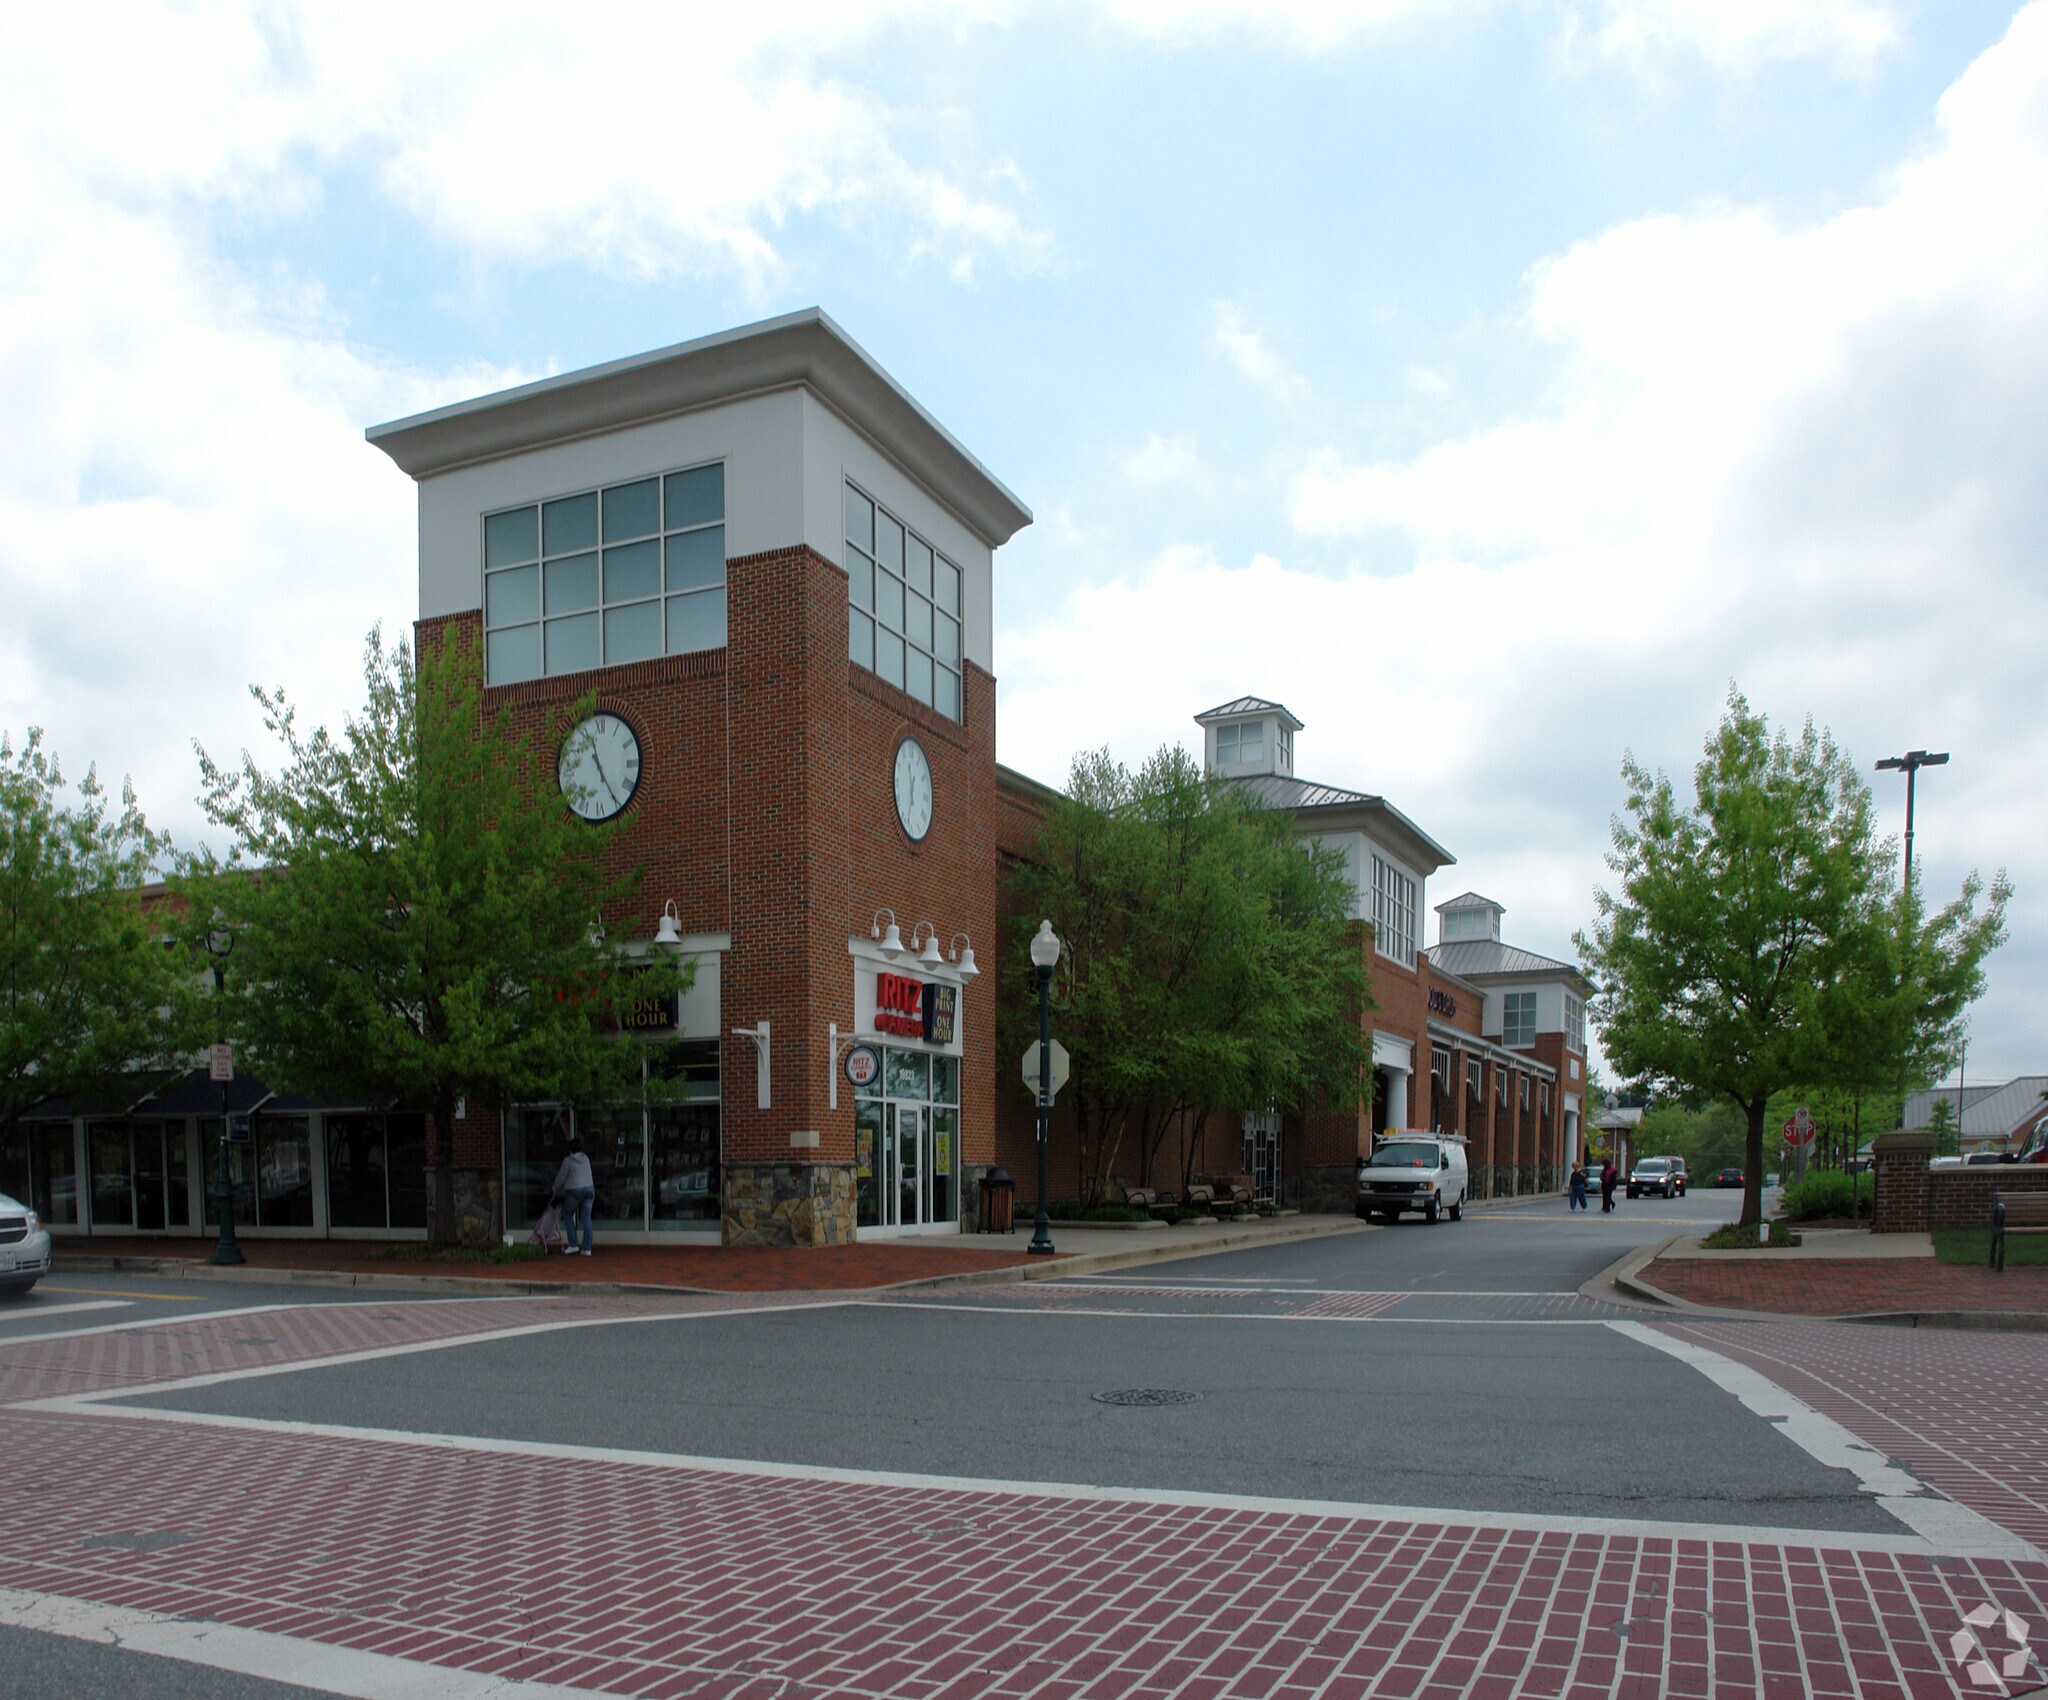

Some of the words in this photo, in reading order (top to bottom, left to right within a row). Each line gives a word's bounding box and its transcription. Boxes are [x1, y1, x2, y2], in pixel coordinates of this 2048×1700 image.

[877, 973, 923, 1014] RITZ
[940, 988, 951, 1000] BIG
[633, 999, 661, 1013] ONE
[935, 998, 954, 1013] PRINT
[626, 1012, 668, 1027] HOUR
[875, 1012, 924, 1038] CAMERA
[936, 1015, 950, 1029] ONE
[933, 1027, 952, 1041] HOUR
[853, 1056, 870, 1066] RITZ
